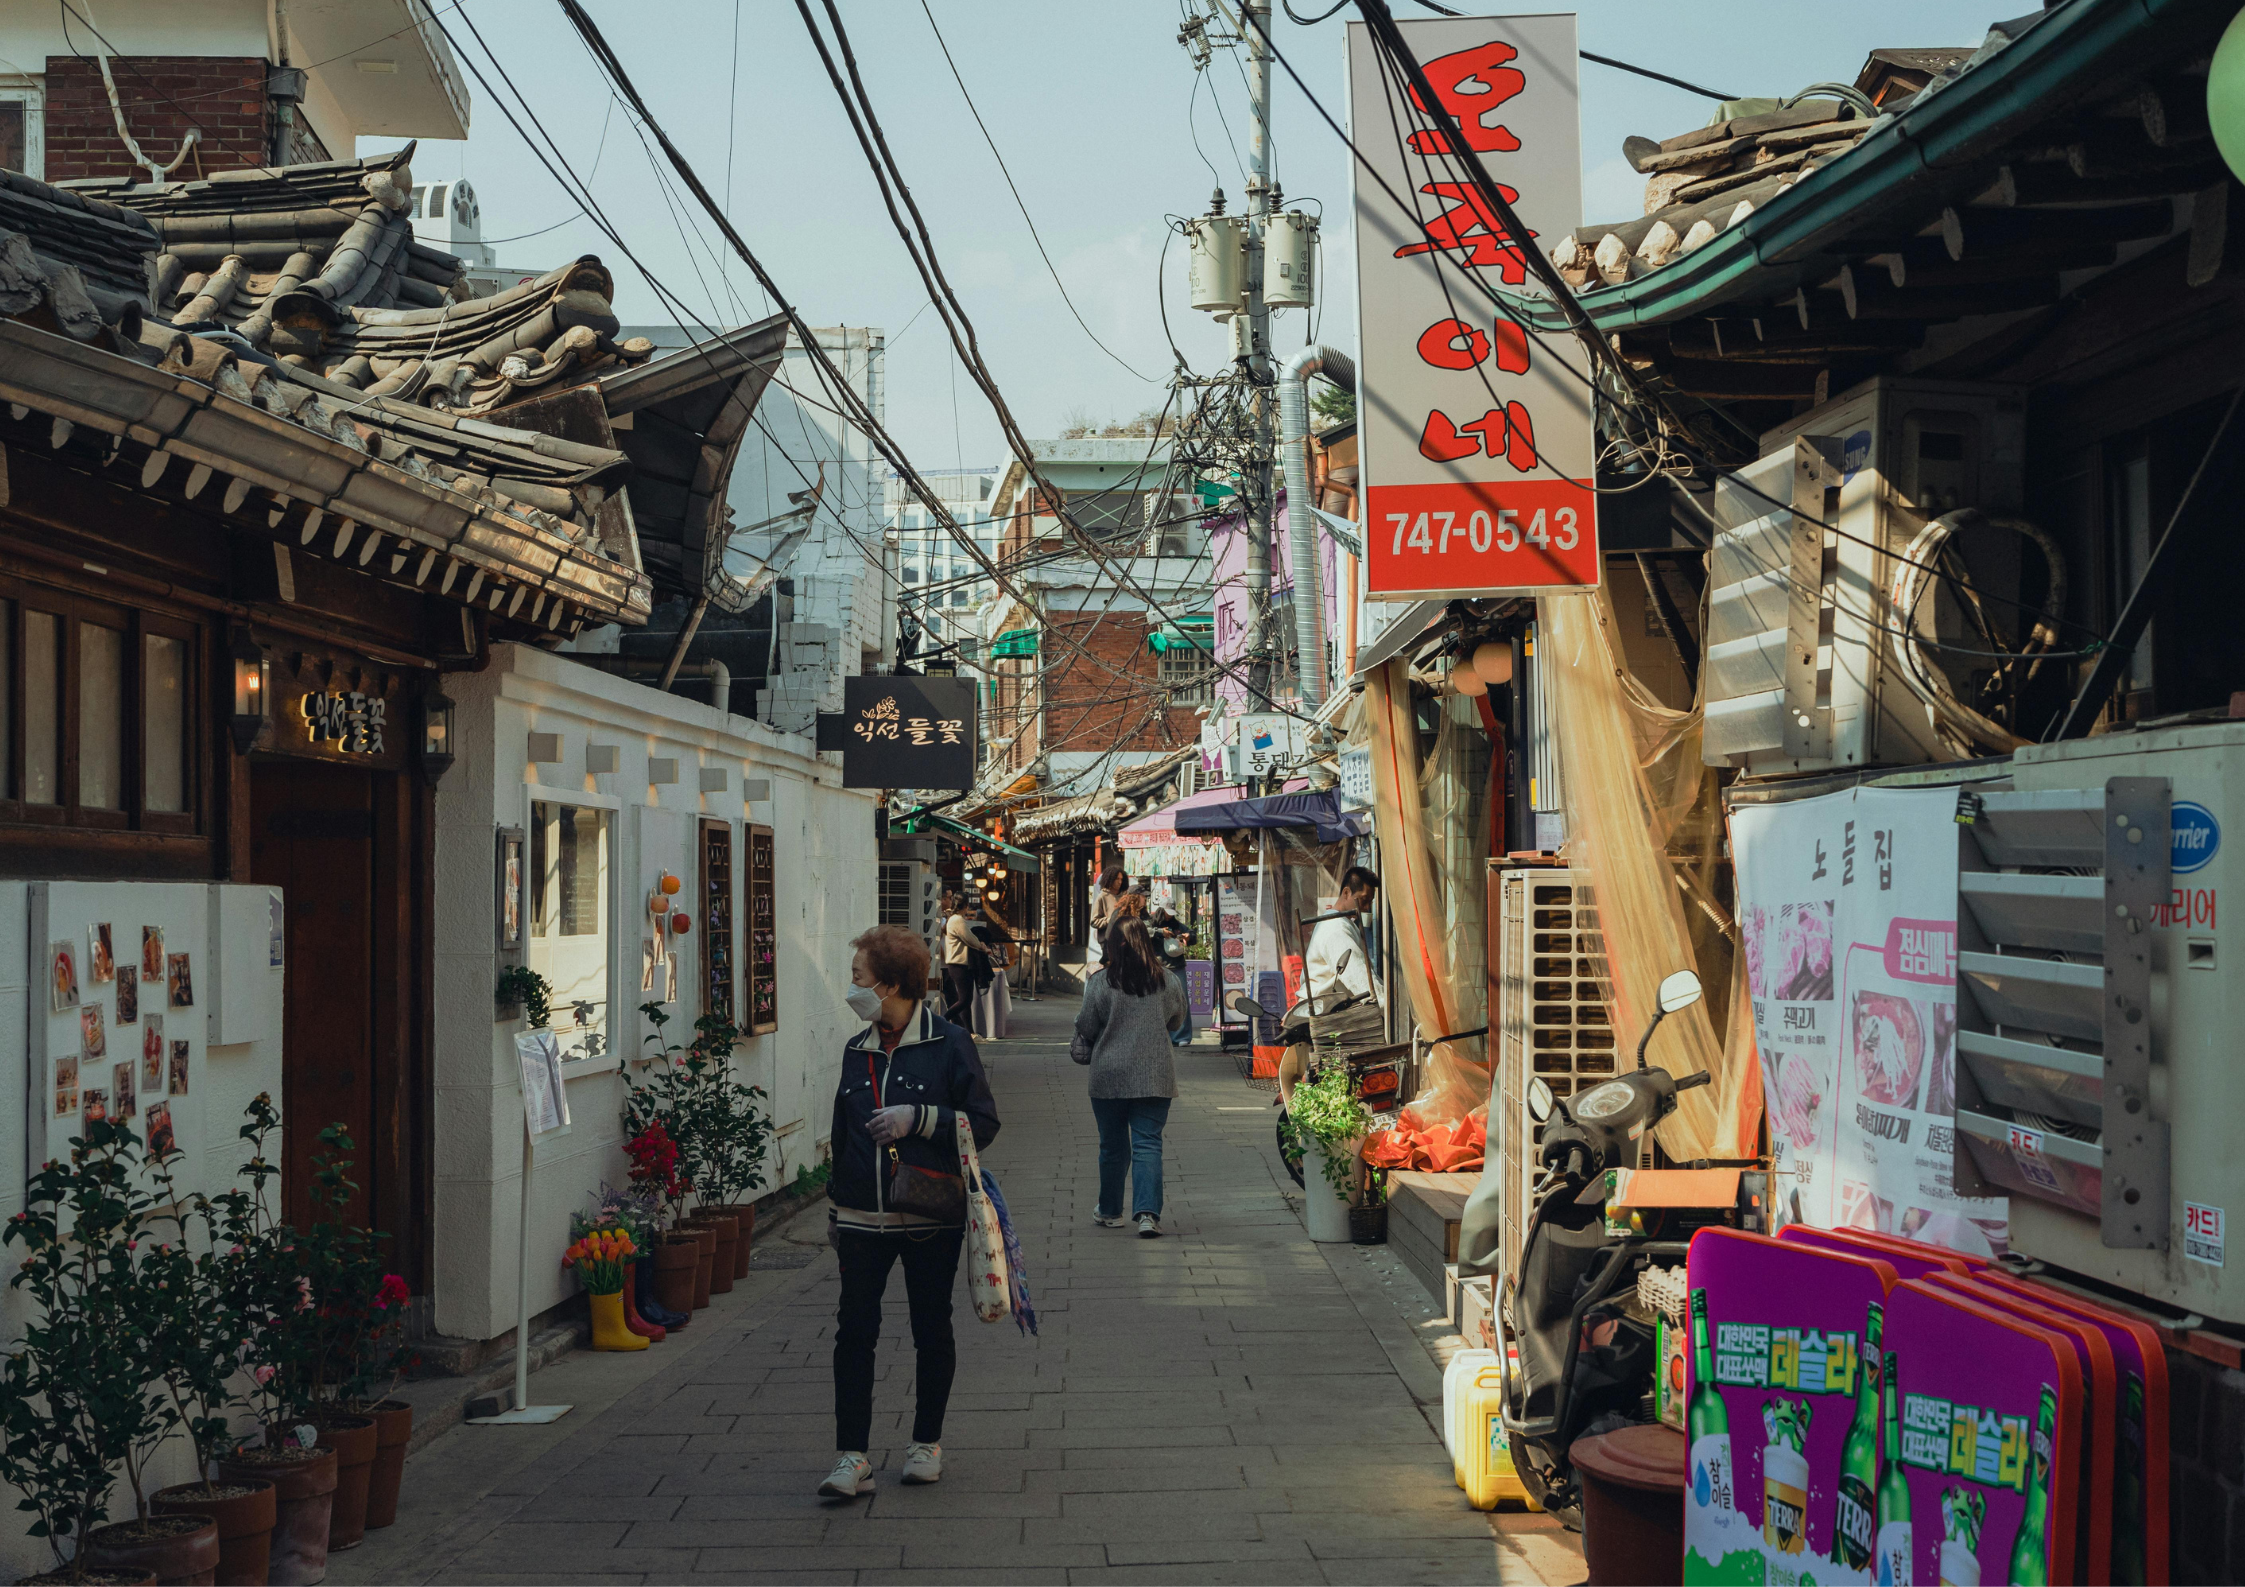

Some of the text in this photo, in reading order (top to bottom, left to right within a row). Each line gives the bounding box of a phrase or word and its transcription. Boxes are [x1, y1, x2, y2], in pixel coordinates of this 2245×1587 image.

[1845, 447, 1867, 472] SUNG
[1386, 506, 1580, 556] 747-0543
[312, 690, 388, 755] 익선들꽃
[1783, 1006, 1816, 1030] 주먹고기
[2187, 1206, 2213, 1236] 카드
[1716, 1324, 1770, 1355] 대한민국
[1715, 1354, 1769, 1386] 대표쏘맥
[1770, 1329, 1858, 1394] 테슬라
[1903, 1395, 1951, 1434] 대한민국
[1901, 1430, 1950, 1471] 대표쏘맥
[1951, 1407, 2030, 1491] 테슬라
[1709, 1457, 1731, 1511] 참이슬
[1767, 1499, 1802, 1540] TERRA
[1836, 1490, 1873, 1553] TERR
